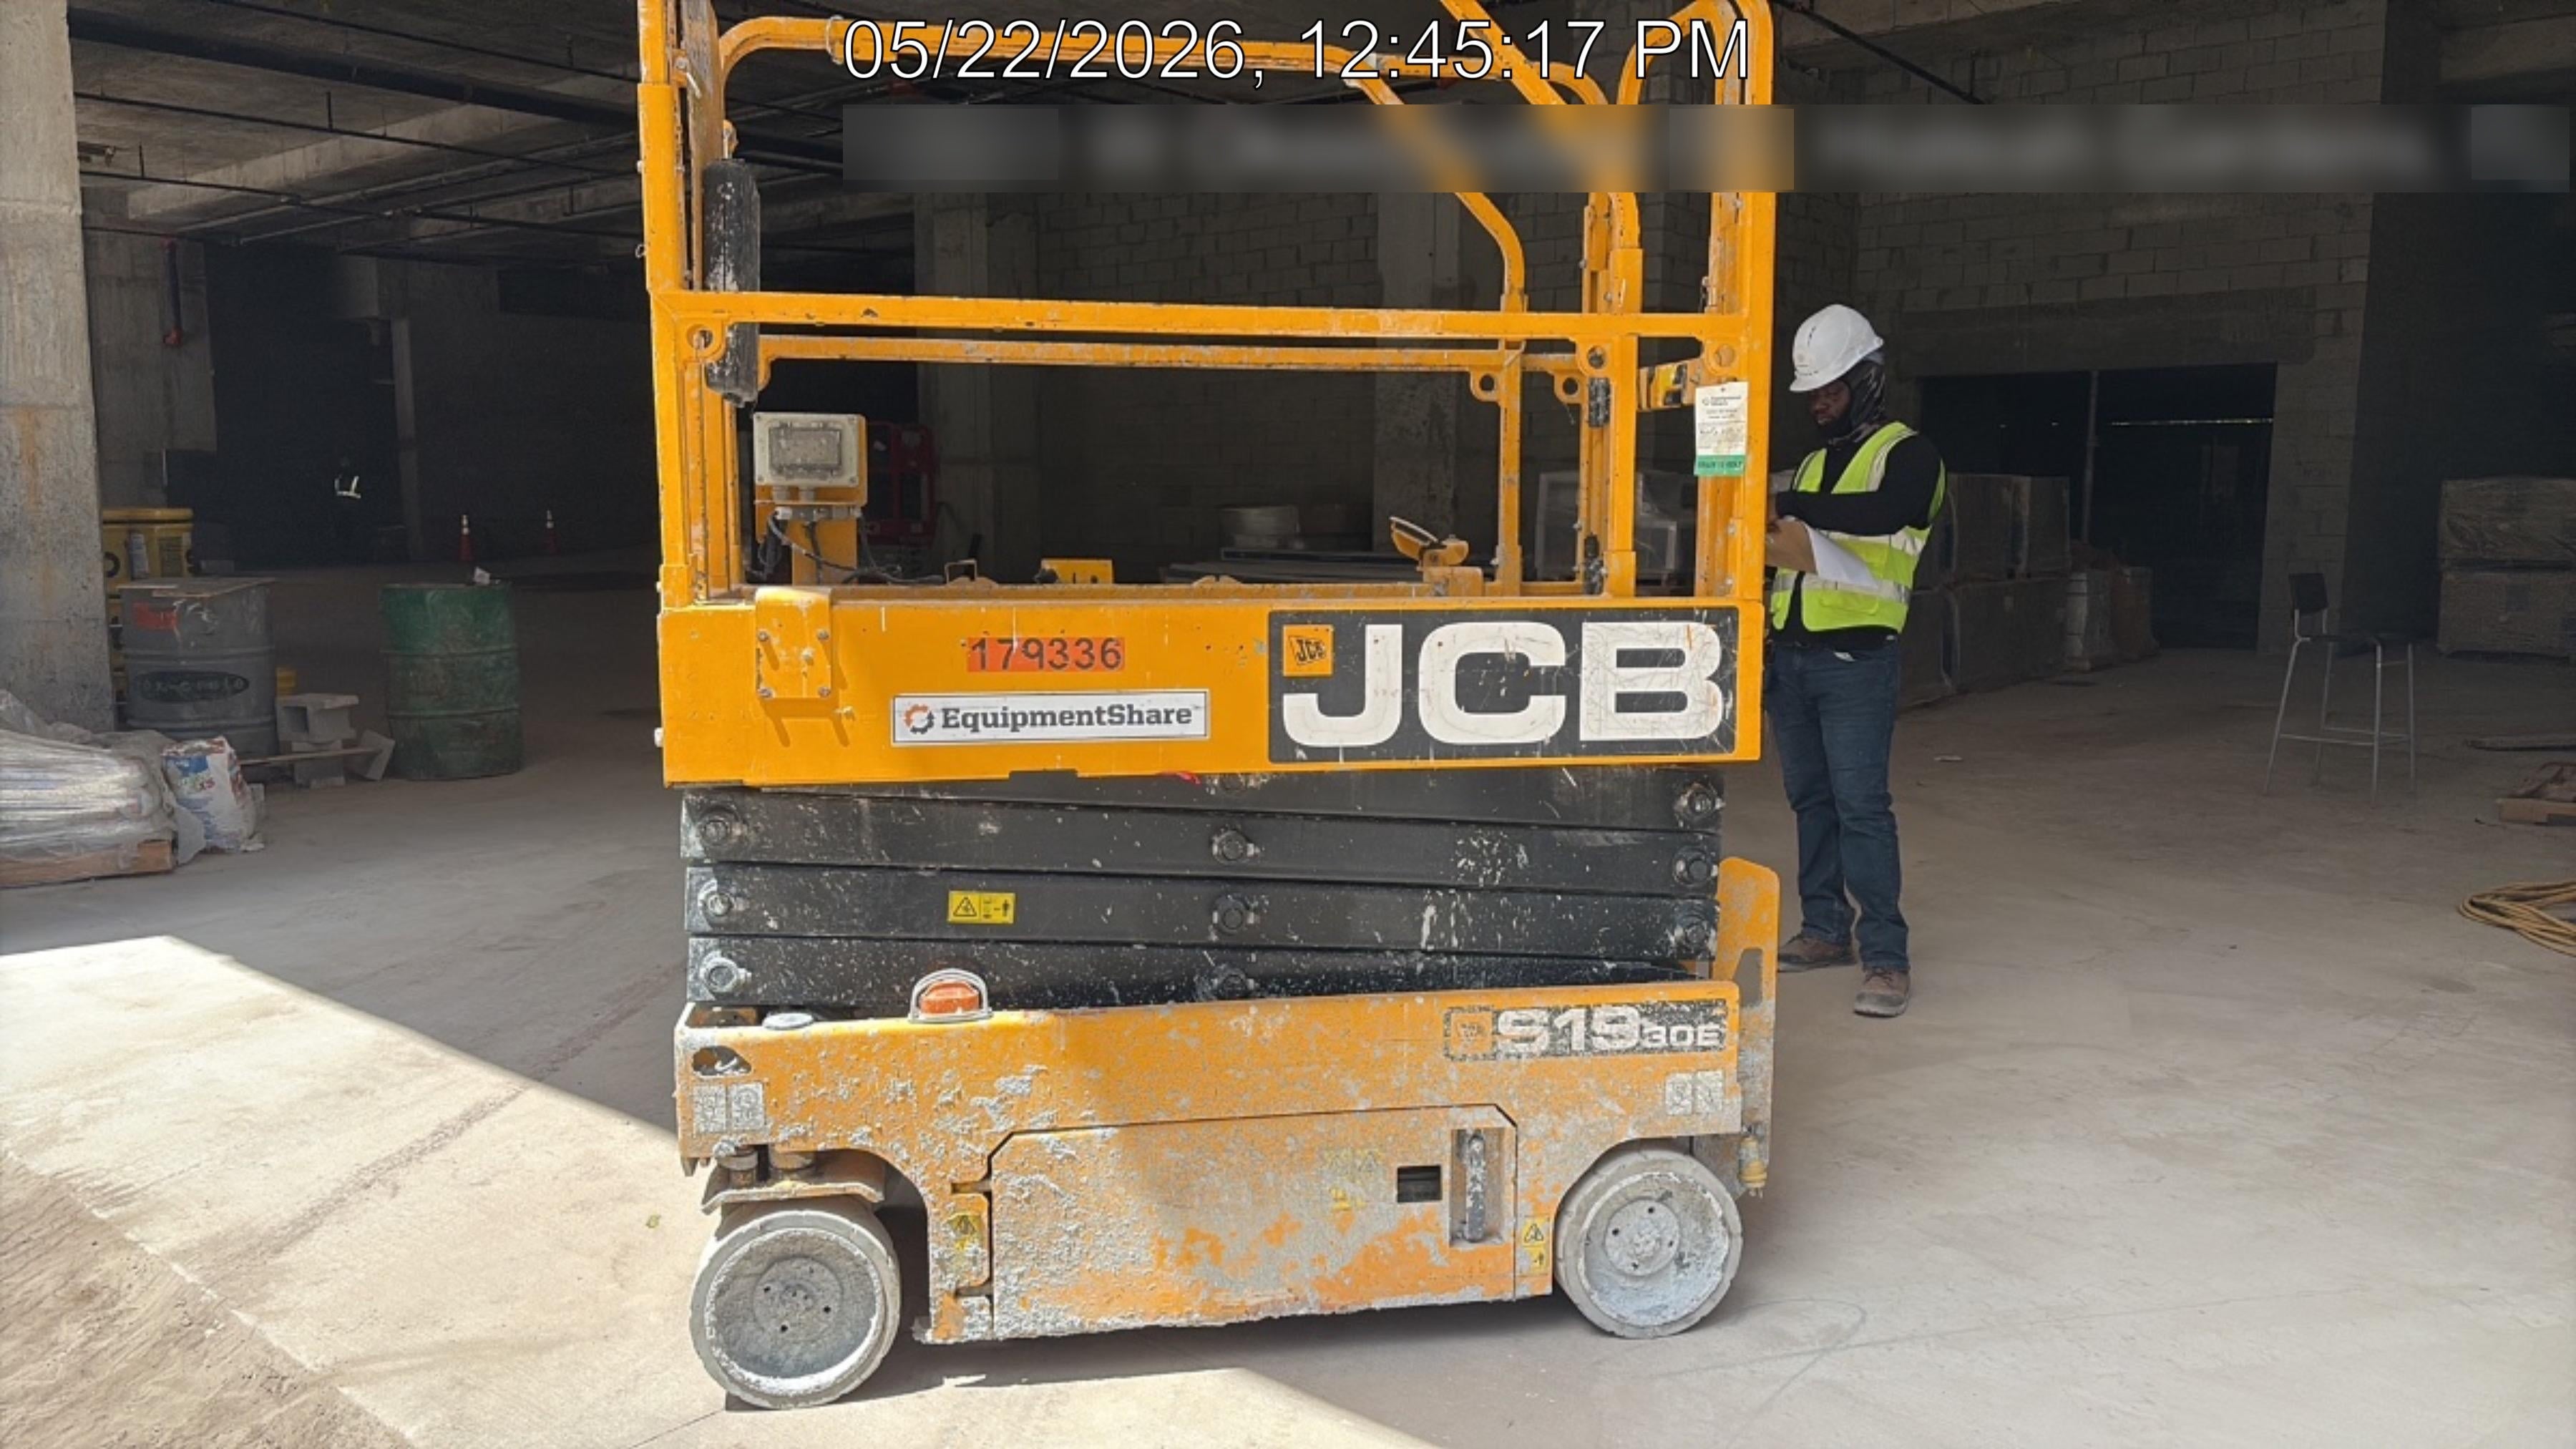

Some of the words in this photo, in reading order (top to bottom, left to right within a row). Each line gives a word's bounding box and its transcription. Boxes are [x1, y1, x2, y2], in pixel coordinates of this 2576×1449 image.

[970, 636, 1123, 671] 179336
[1283, 621, 1723, 747] JCB
[941, 704, 1192, 733] EquipmentShare
